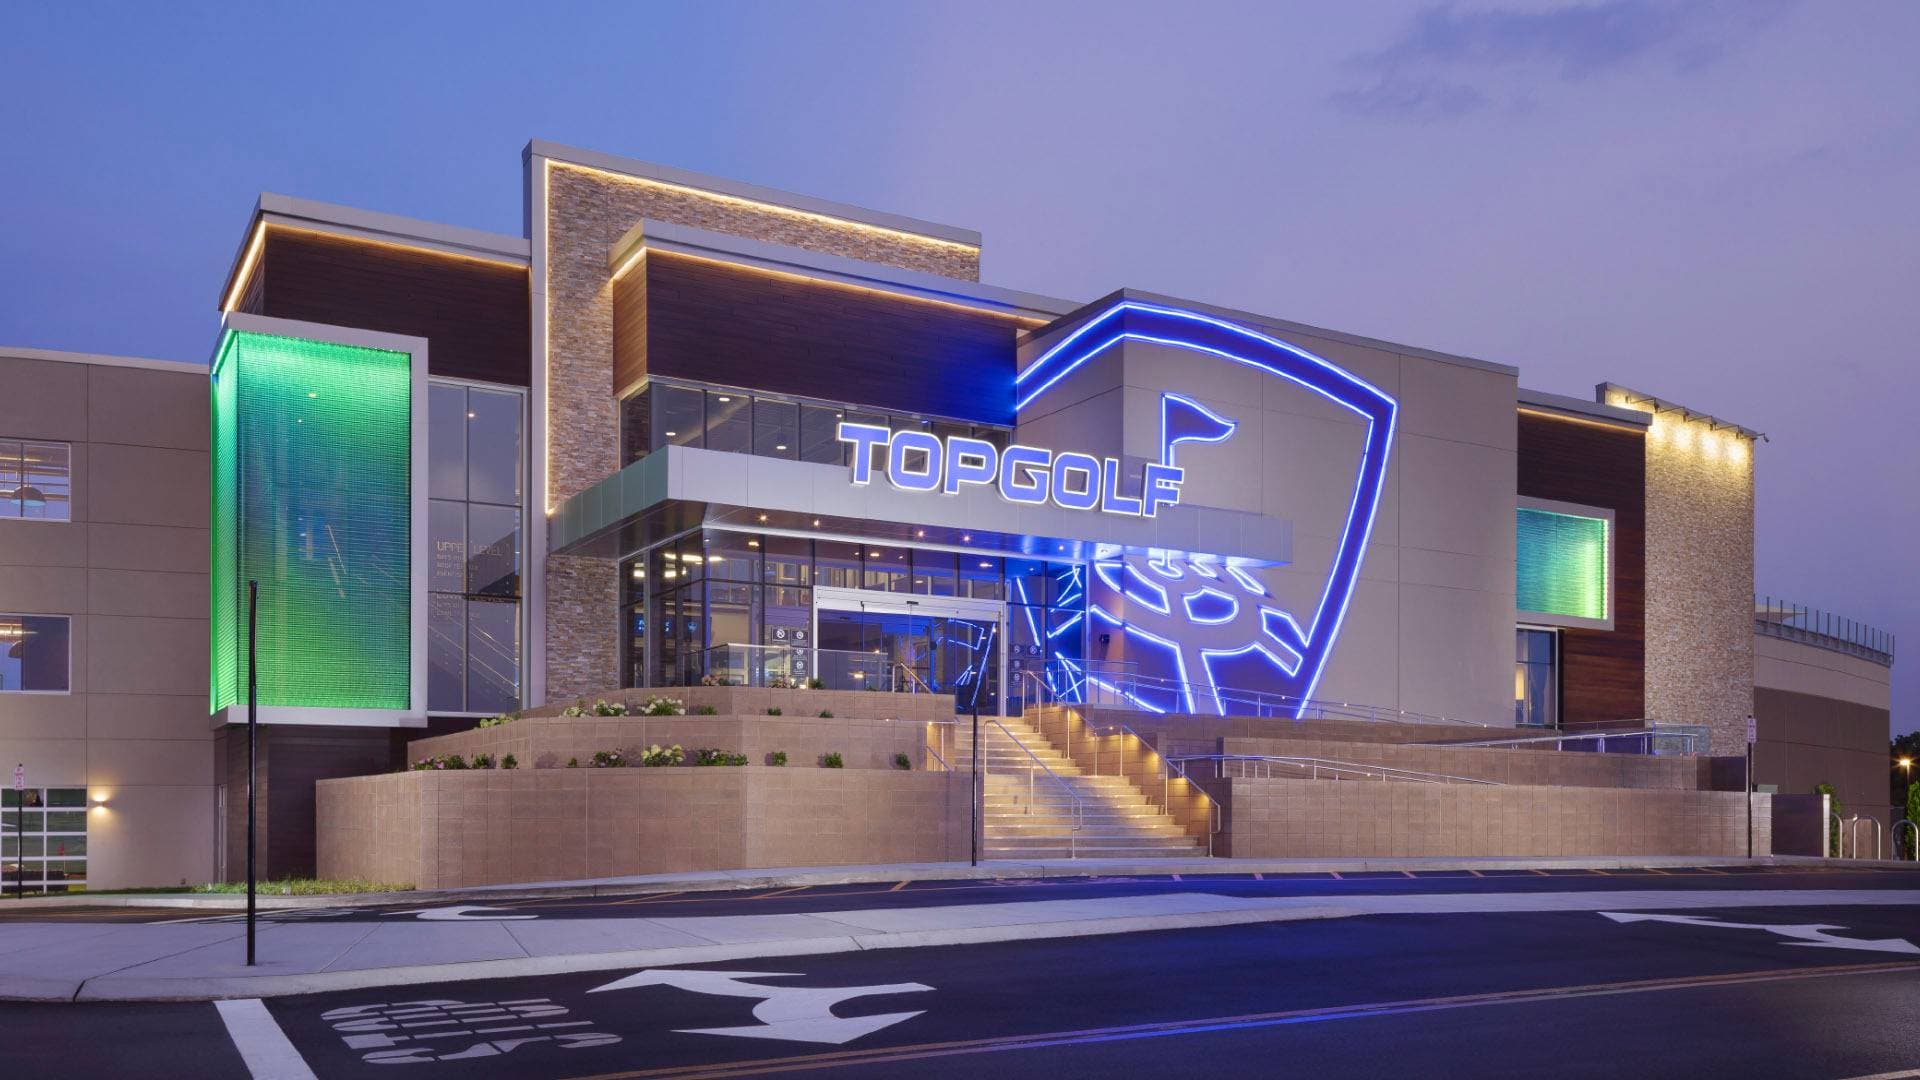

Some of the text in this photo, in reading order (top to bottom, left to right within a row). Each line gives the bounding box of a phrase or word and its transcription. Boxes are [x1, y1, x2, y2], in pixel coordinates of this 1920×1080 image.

[838, 422, 1184, 517] TOPGOLF
[437, 541, 466, 553] UPPE
[320, 998, 624, 1065] STOP
